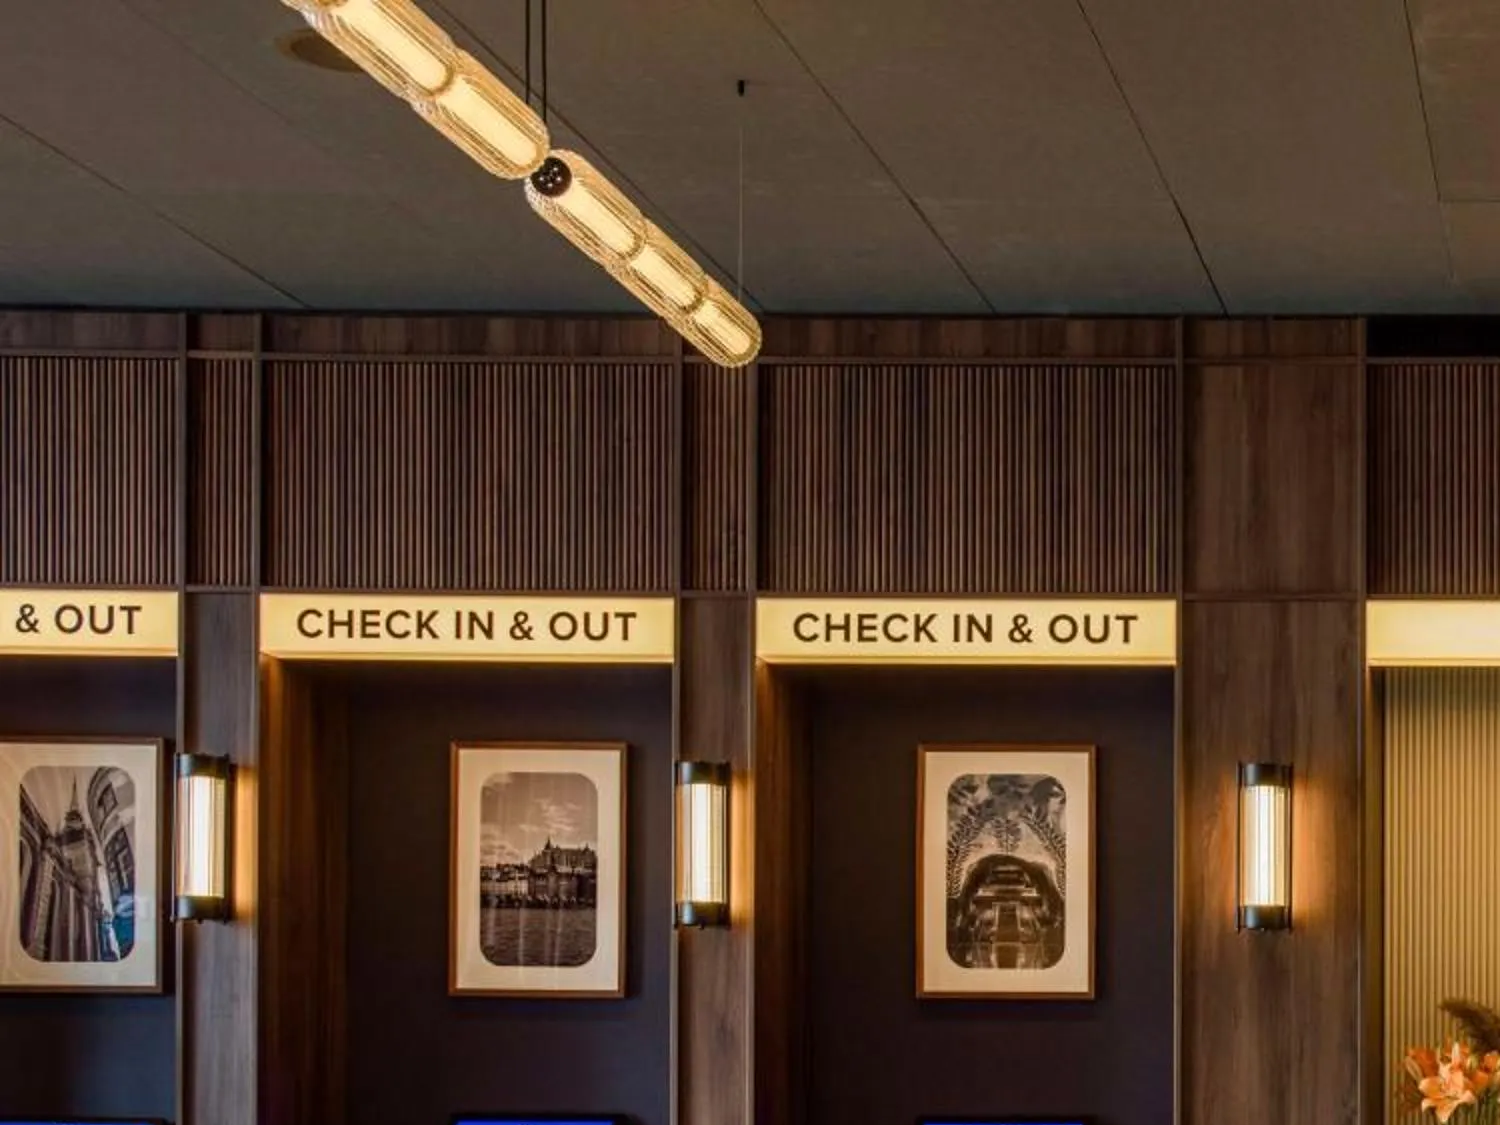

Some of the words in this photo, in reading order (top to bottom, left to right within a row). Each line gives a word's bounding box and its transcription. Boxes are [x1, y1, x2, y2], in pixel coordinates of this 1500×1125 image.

[16, 604, 39, 634] &
[54, 605, 142, 635] OUT
[296, 608, 439, 640] CHECK
[454, 610, 494, 641] IN
[509, 610, 534, 641] &
[548, 611, 637, 642] OUT
[793, 612, 938, 643] CHECK
[953, 613, 993, 643] IN
[1007, 613, 1033, 644] &
[1048, 613, 1139, 644] OUT
